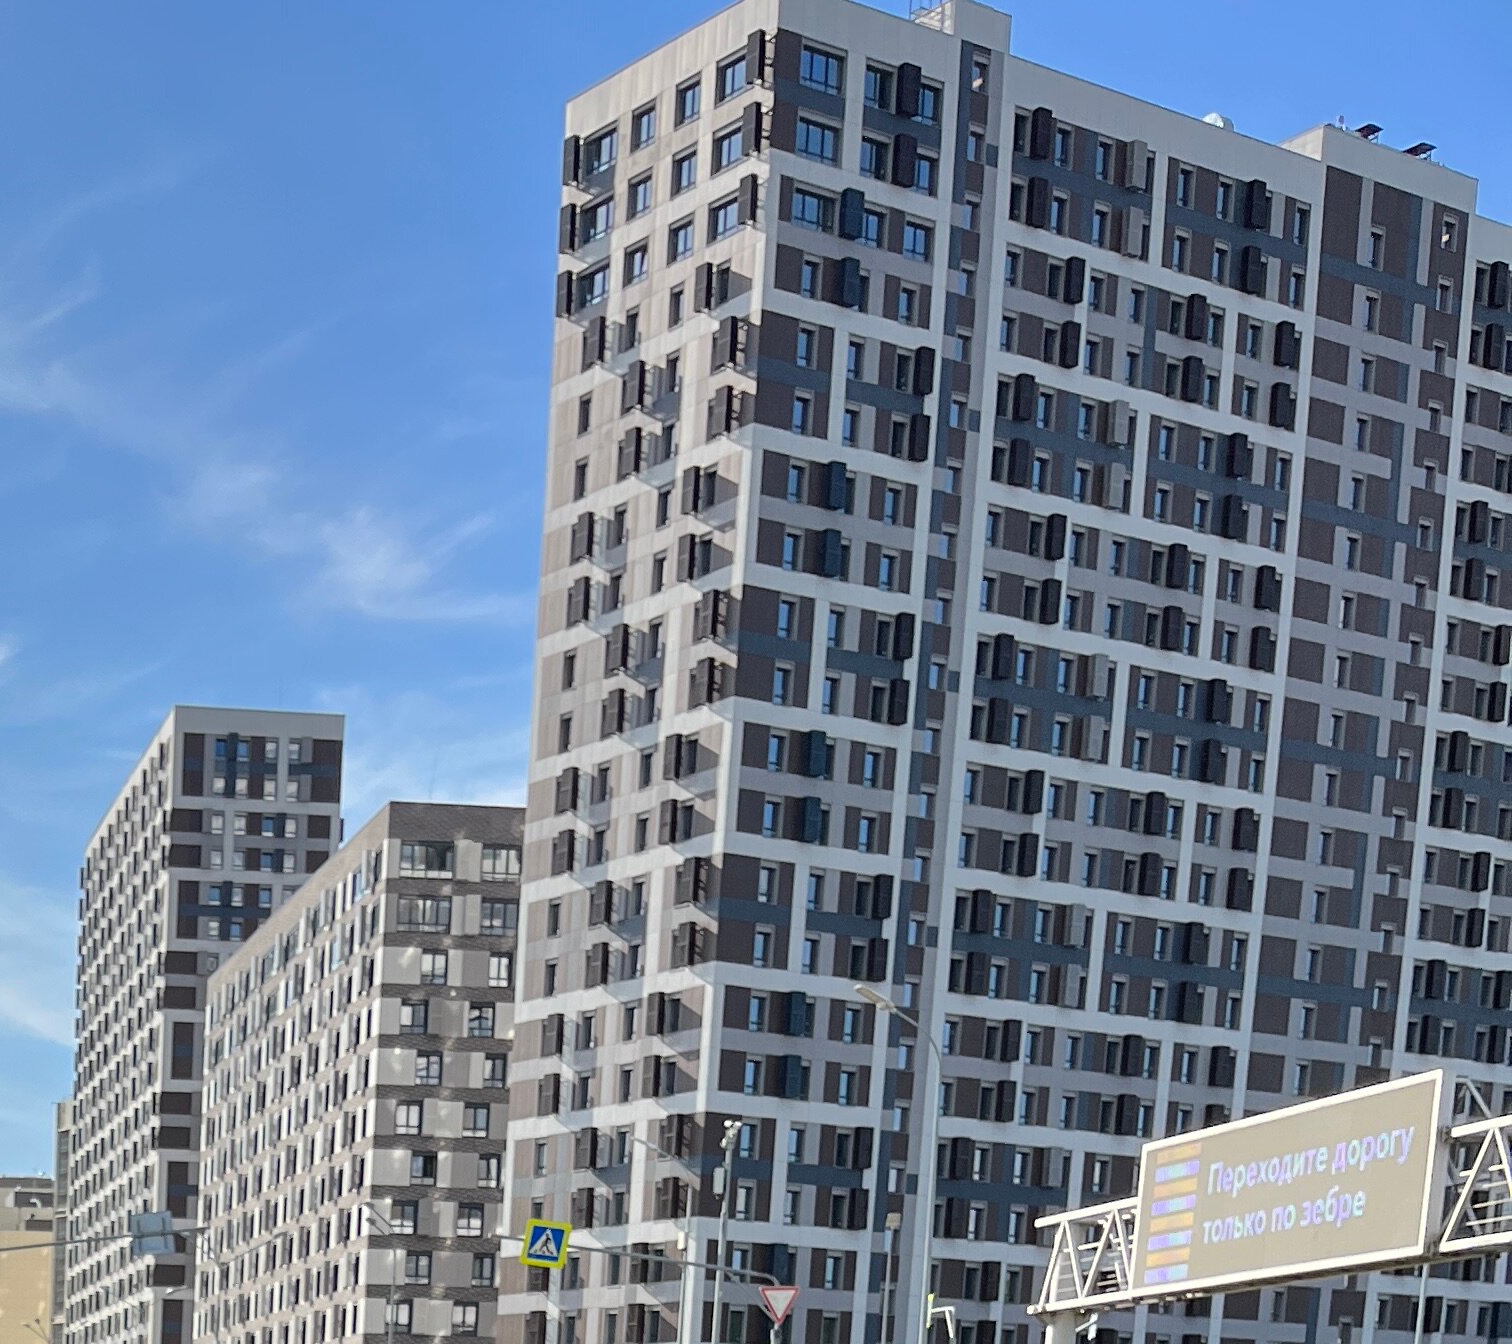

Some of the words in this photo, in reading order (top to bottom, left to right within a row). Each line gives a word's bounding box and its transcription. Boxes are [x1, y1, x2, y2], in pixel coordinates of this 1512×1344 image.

[1207, 1146, 1329, 1198] Переходите
[1331, 1125, 1416, 1175] дорогу
[1202, 1208, 1267, 1245] только
[1271, 1203, 1297, 1233] по
[1299, 1184, 1367, 1229] зебре
